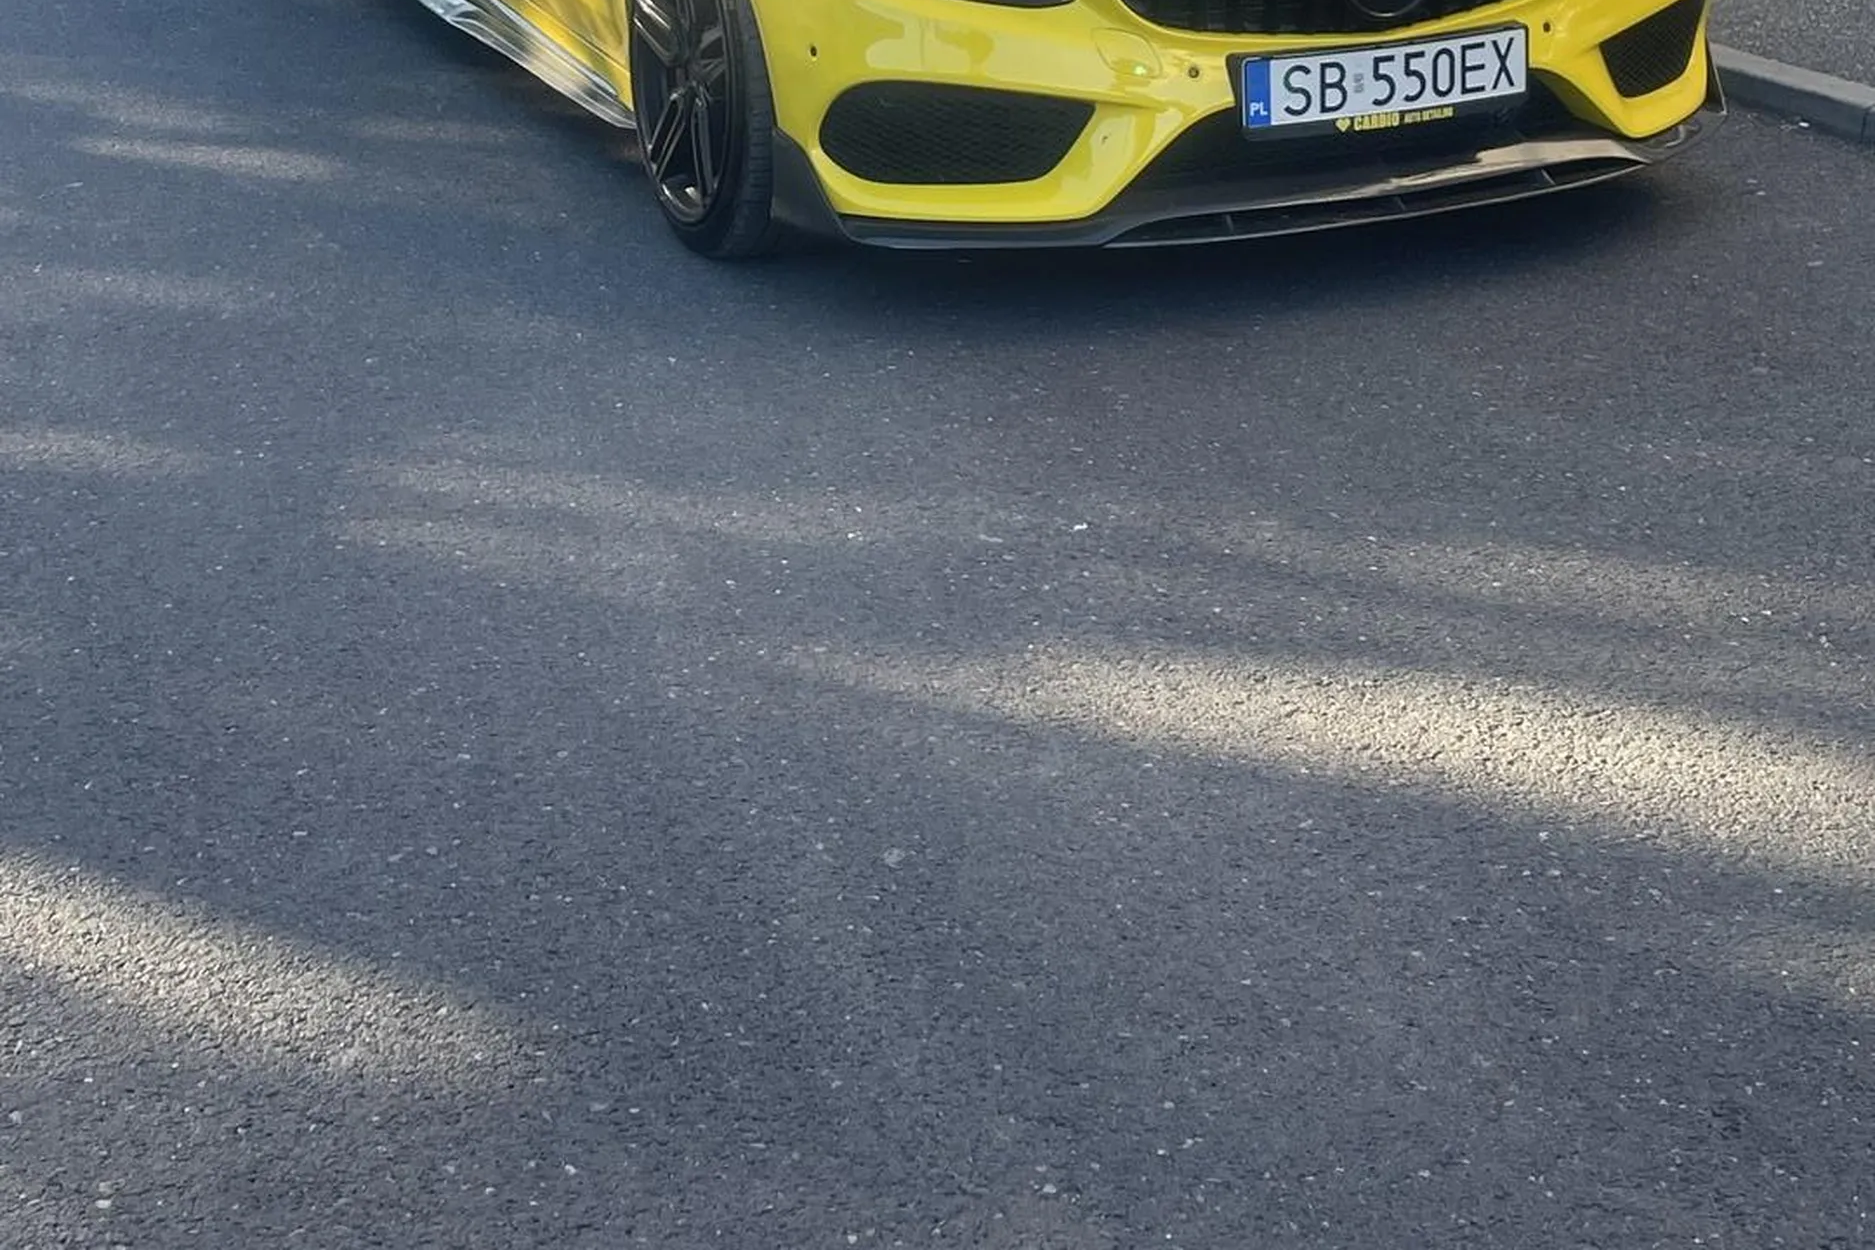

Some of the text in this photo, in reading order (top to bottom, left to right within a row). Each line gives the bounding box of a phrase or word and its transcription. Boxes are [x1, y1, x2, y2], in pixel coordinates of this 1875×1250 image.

[1282, 36, 1515, 117] SB 550EX
[1249, 101, 1269, 117] PL
